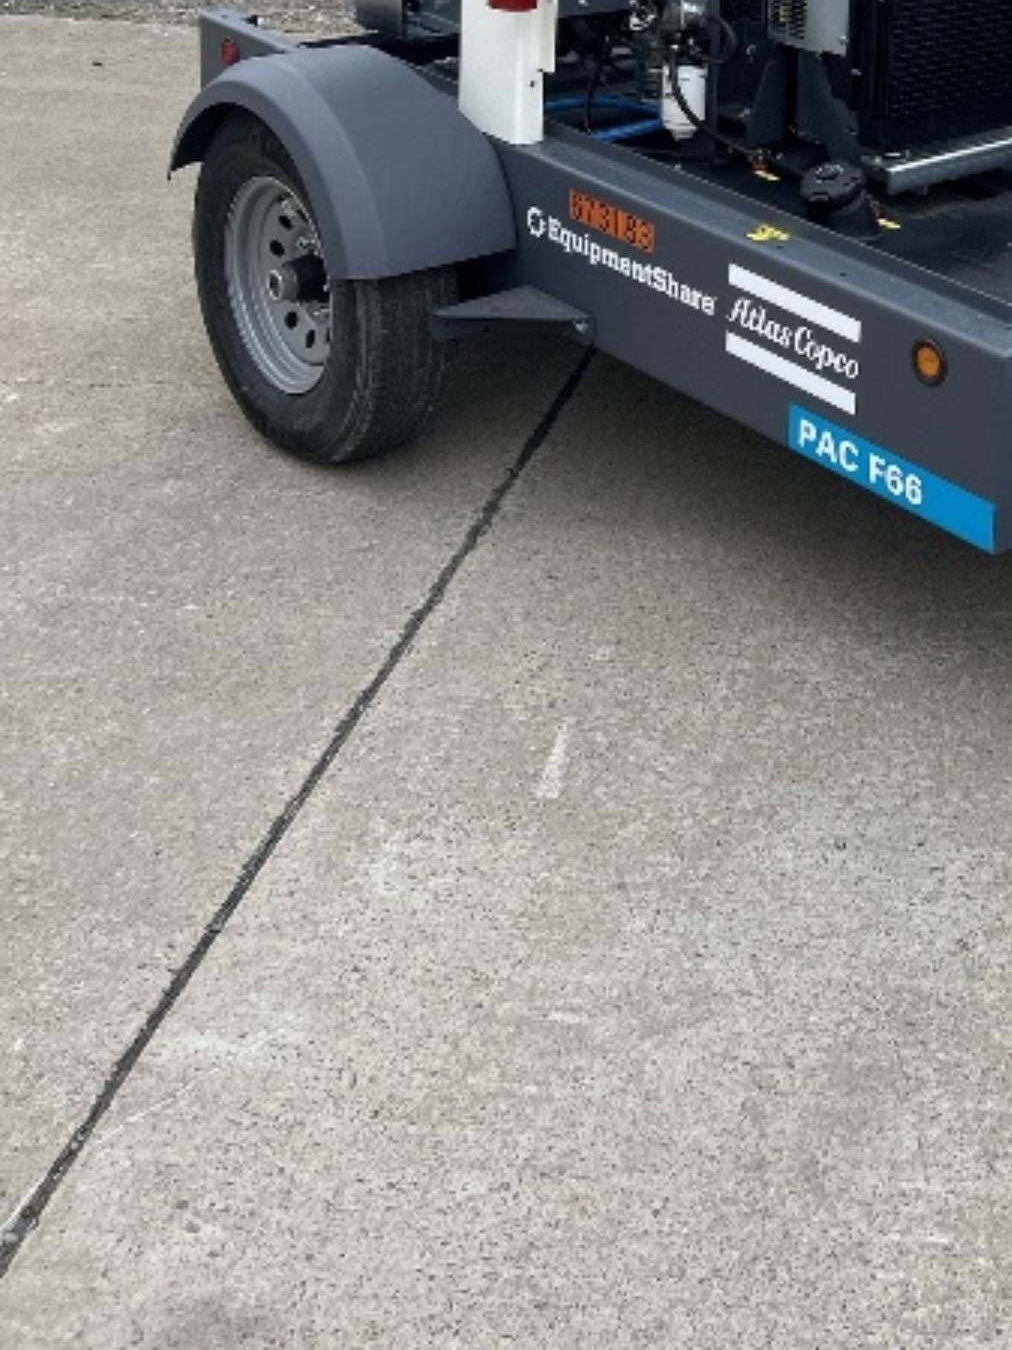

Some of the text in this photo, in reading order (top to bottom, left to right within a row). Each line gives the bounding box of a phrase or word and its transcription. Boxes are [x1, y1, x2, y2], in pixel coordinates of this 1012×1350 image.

[548, 215, 717, 315] EquipmentShare
[725, 297, 860, 379] Atlas Copco
[798, 417, 923, 506] PAC F66
